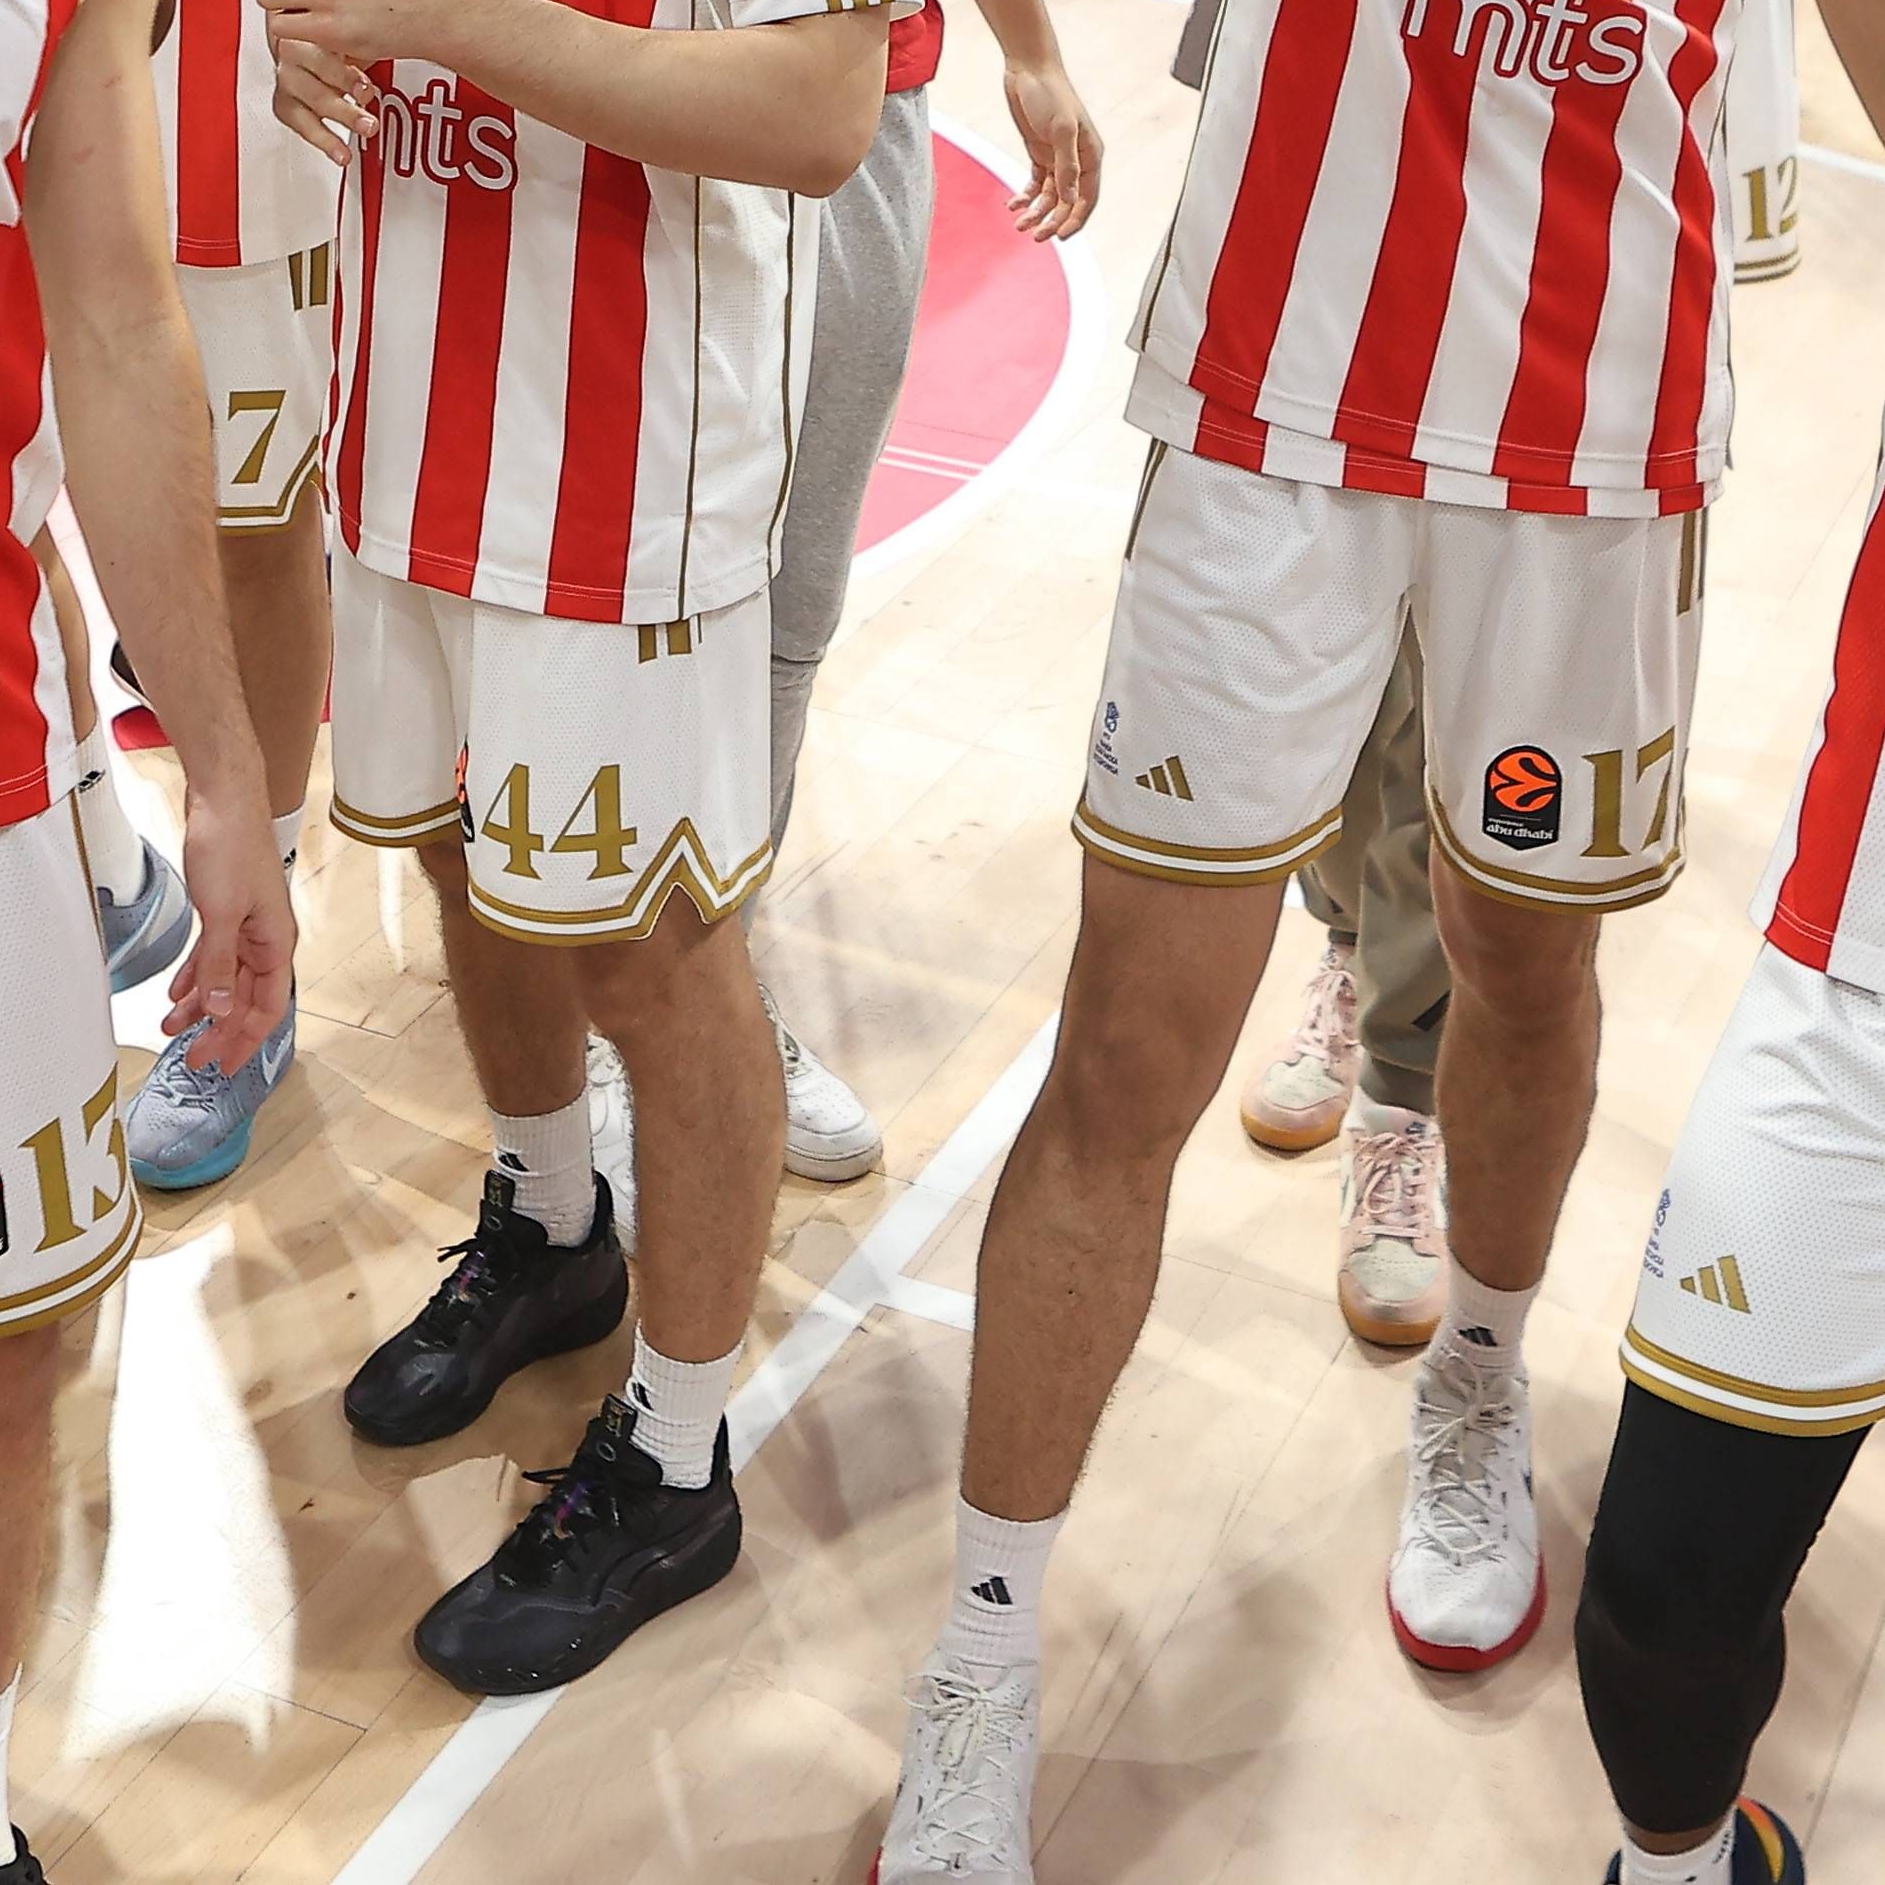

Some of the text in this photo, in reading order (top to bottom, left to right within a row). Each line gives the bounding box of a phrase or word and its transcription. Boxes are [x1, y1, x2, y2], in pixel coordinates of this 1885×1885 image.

[227, 390, 286, 485] 7
[481, 763, 639, 881] 44
[1582, 726, 1676, 858] 17
[18, 1061, 125, 1255] 13
